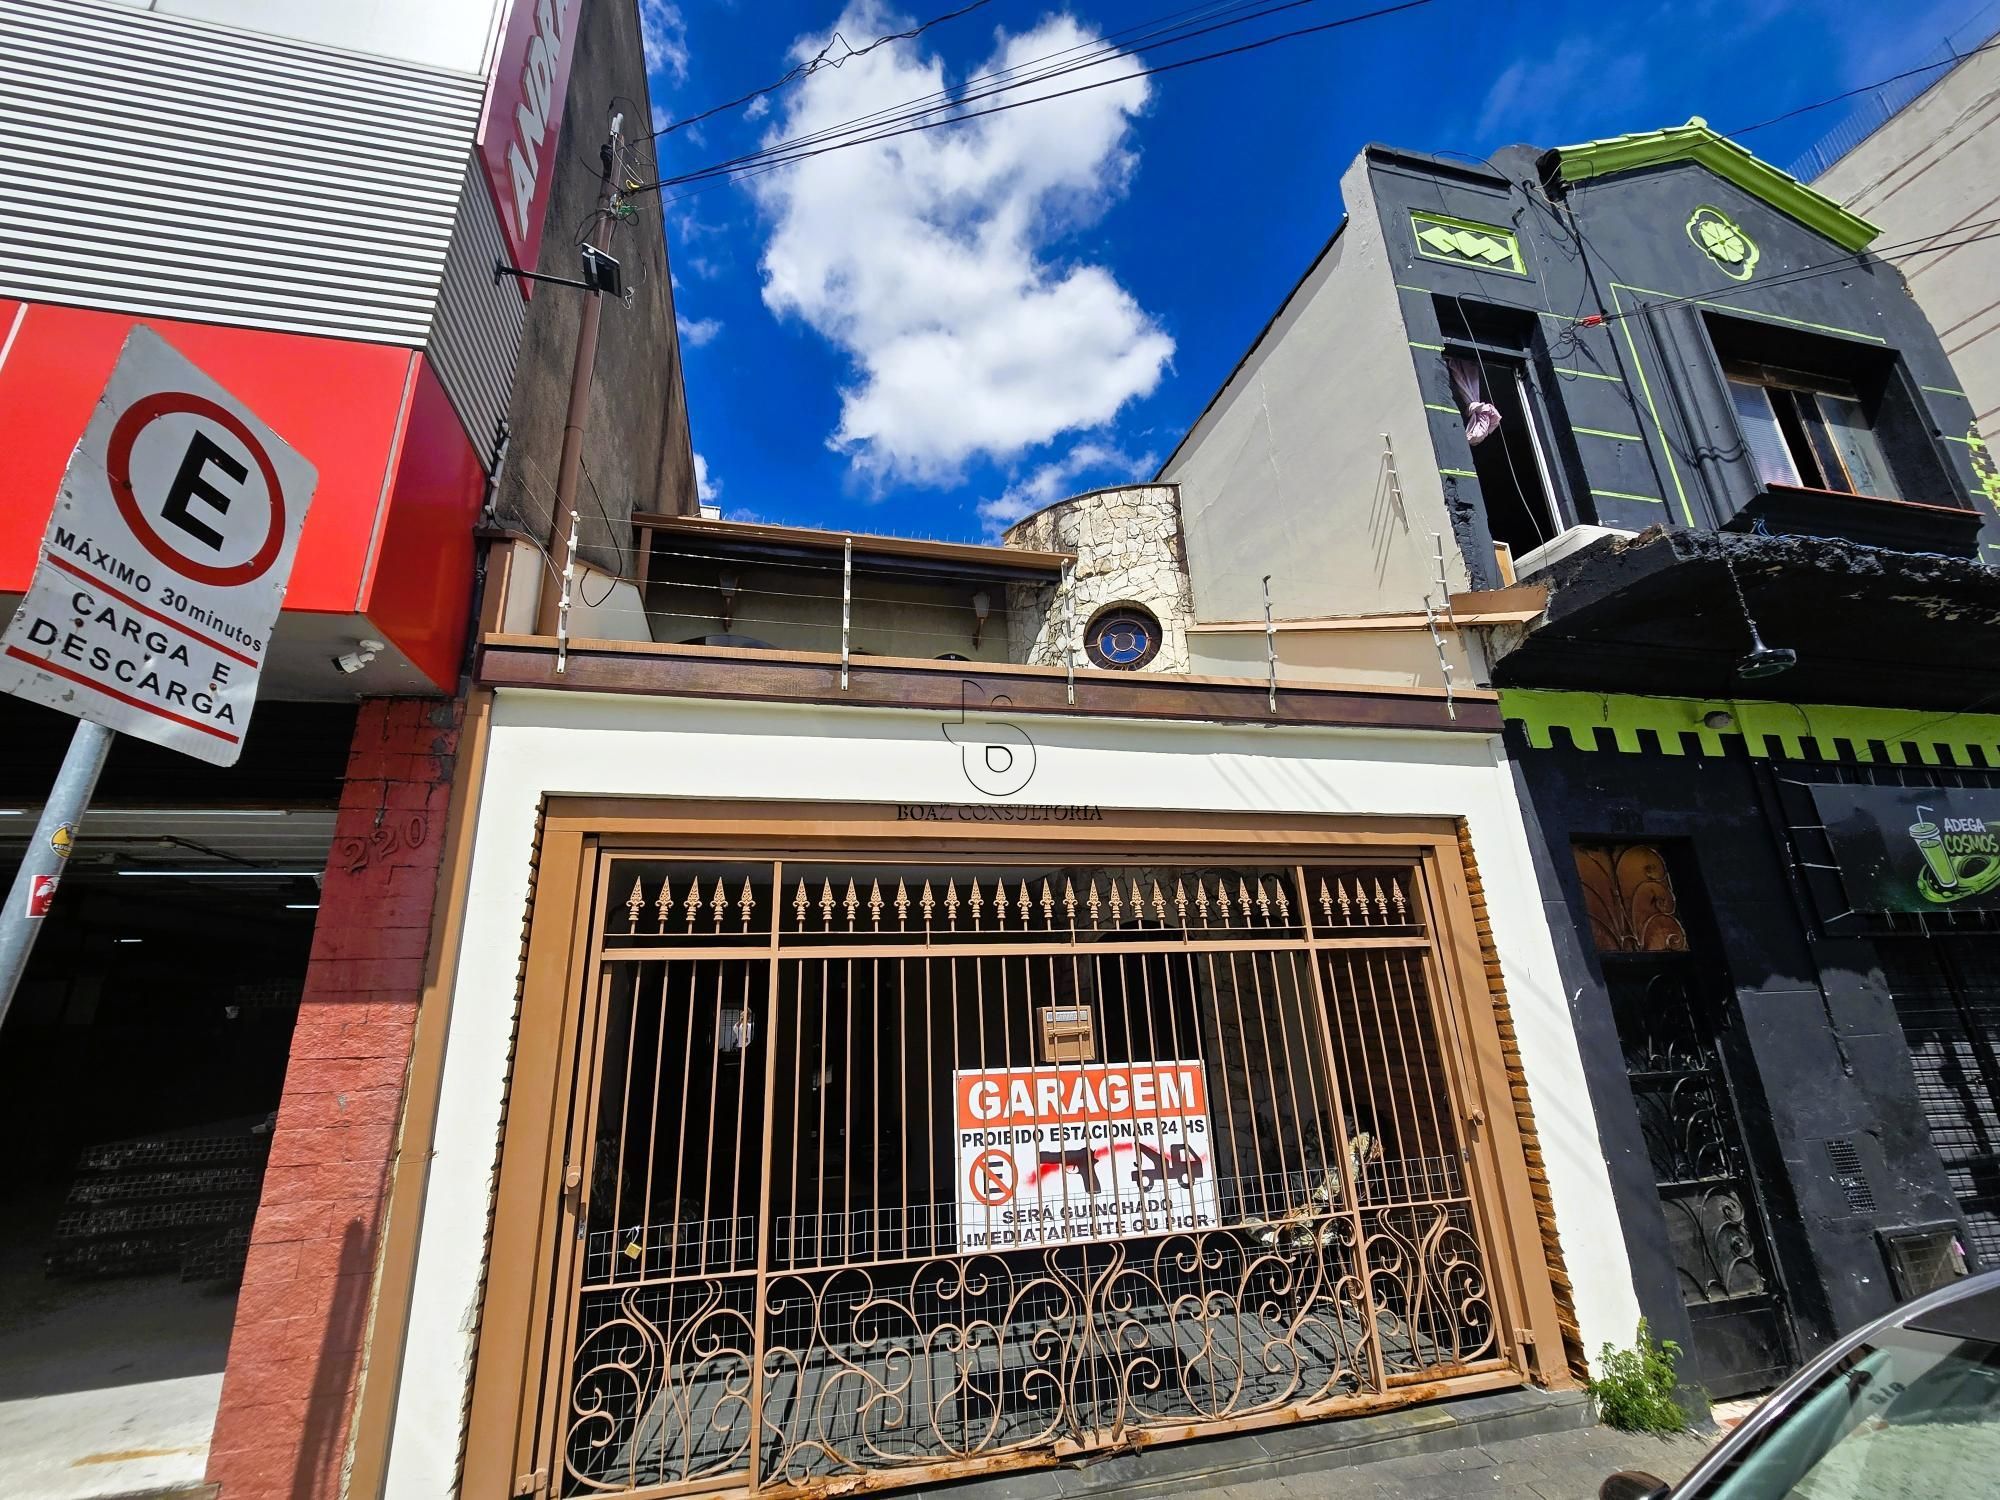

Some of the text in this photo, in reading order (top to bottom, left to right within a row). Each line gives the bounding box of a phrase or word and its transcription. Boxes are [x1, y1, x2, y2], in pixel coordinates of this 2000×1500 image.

[161, 429, 249, 552] E
[54, 526, 151, 593] MÁXIMO
[71, 592, 231, 685] CARGA E
[27, 618, 235, 725] DESCARGA
[342, 815, 427, 876] 220
[1943, 817, 1987, 833] ADEGA
[1944, 834, 2000, 854] COSMOS
[968, 1071, 1196, 1120] GARAGEM
[961, 1119, 1205, 1148] PROIBIDO ESTACIONAR 24 HS
[1002, 1198, 1173, 1224] SERÁ GUINCHADO
[1132, 1217, 1159, 1232] OU
